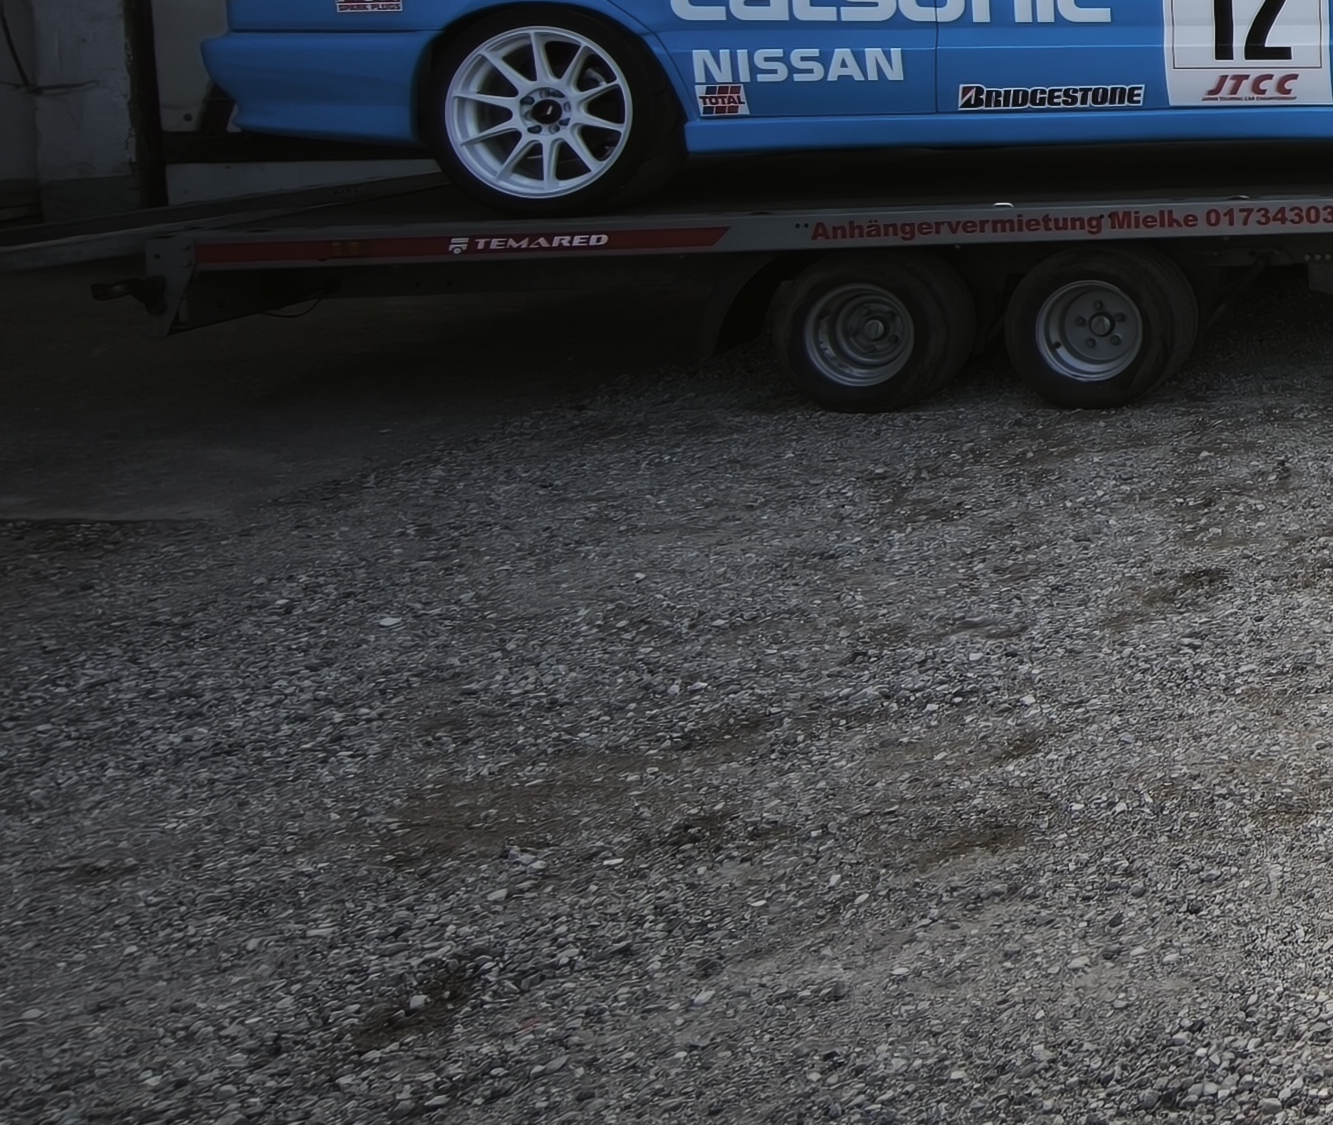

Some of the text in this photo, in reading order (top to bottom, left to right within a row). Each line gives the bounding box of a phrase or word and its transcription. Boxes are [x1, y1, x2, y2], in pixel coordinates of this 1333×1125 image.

[692, 48, 904, 83] NISSAN
[1204, 73, 1299, 96] JTCC
[699, 95, 745, 105] TOTAL
[959, 84, 1145, 110] BRIDGESTONE
[811, 213, 1103, 241] Anhängervermietung
[474, 234, 609, 250] TEMARED
